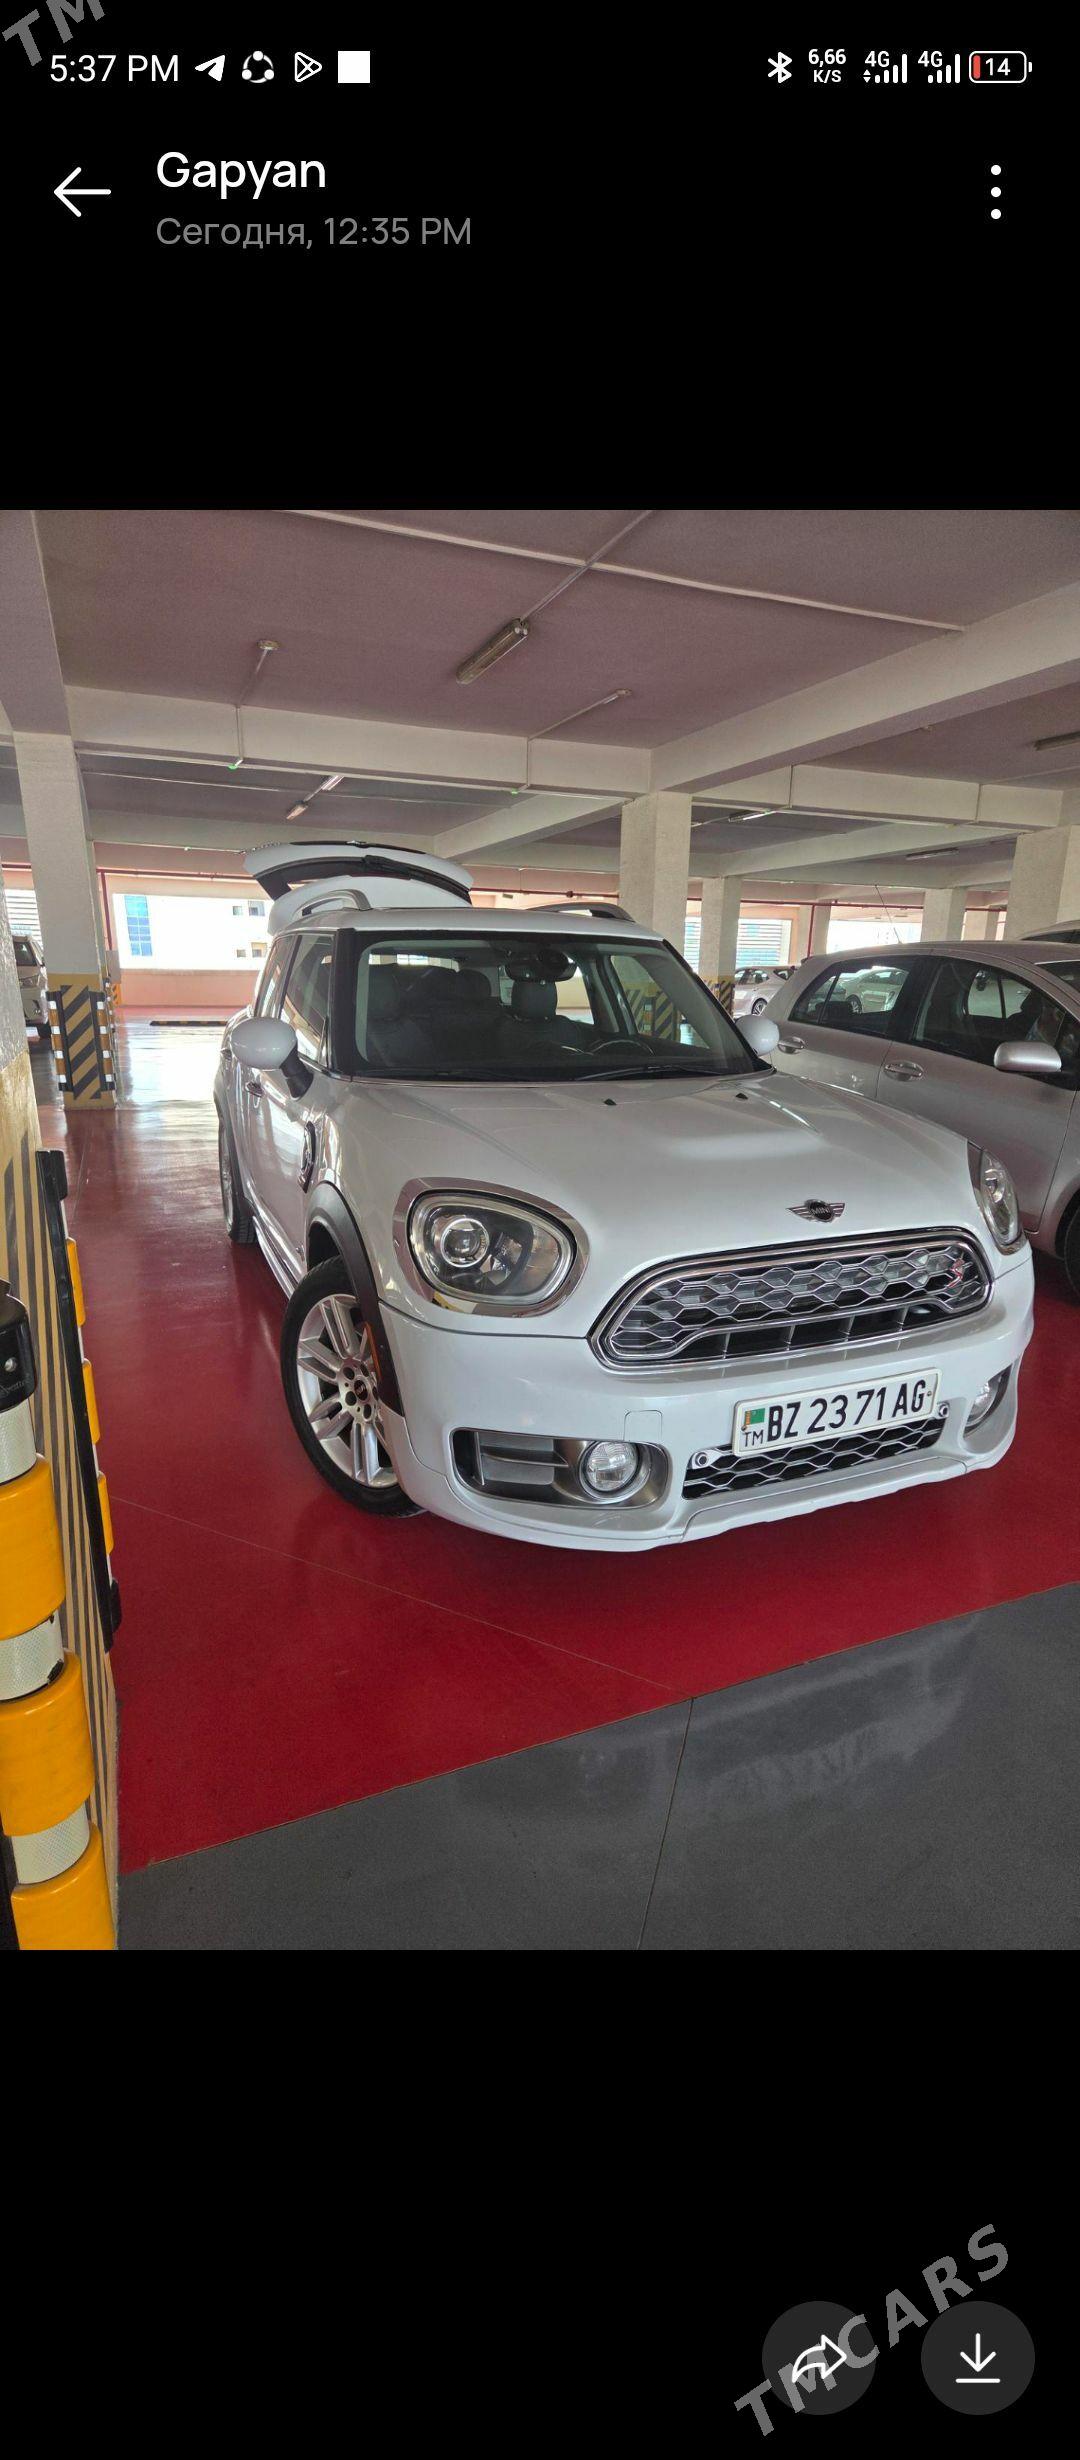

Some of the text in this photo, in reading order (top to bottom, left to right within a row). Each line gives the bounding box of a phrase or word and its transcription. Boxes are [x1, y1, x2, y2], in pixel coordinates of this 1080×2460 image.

[808, 48, 847, 68] 6,66
[864, 50, 890, 68] 4G
[917, 50, 943, 68] 4G
[985, 57, 1011, 76] 14
[50, 54, 179, 83] 5:37 PM
[813, 69, 842, 84] K/S
[156, 151, 326, 200] Gapyan
[156, 217, 471, 250] Сегодня, 12:35 PM
[767, 1401, 801, 1443] BZ
[891, 1379, 927, 1418] AG
[744, 1429, 764, 1448] TM
